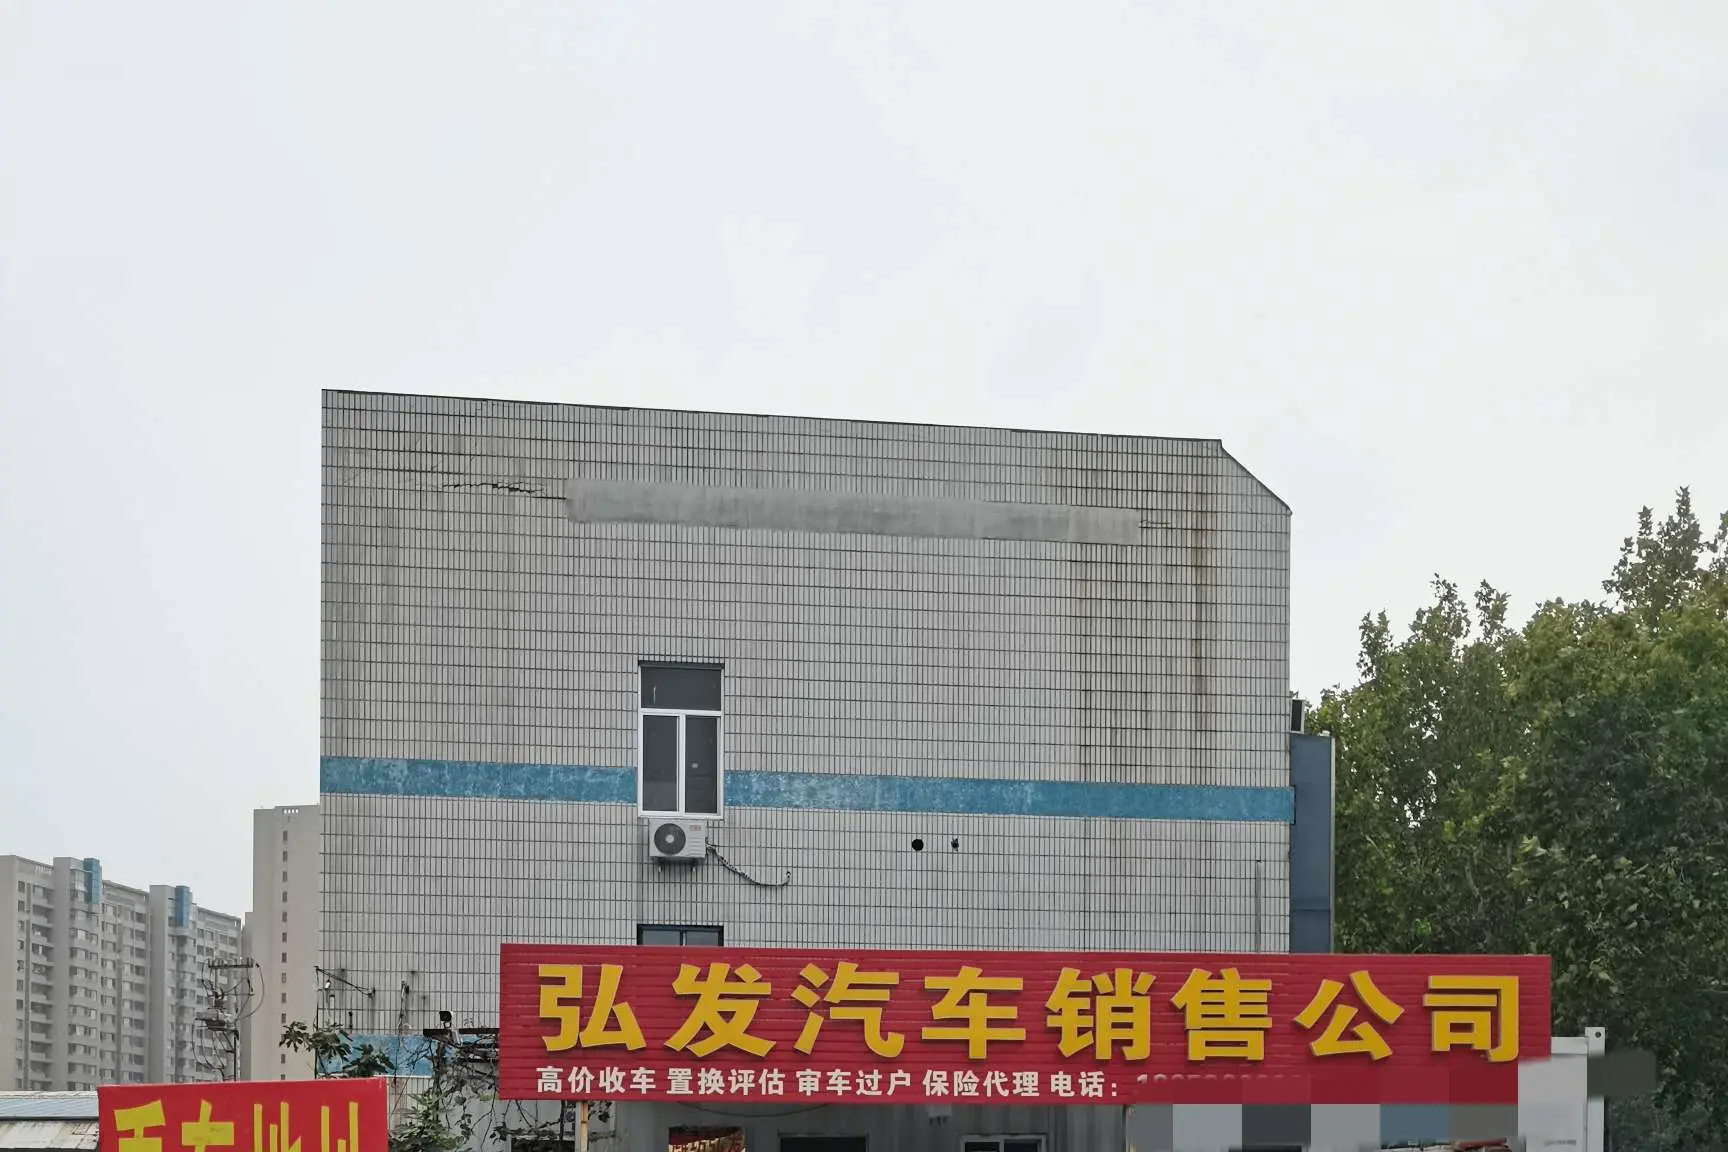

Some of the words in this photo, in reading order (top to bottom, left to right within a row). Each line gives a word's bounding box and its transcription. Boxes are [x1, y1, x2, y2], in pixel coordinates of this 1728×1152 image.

[540, 963, 1518, 1062] 弘发汽车销售公司
[536, 1065, 656, 1094] 高价收车
[666, 1067, 786, 1096] 置换评估
[795, 1068, 911, 1097] 审车过户
[922, 1069, 1040, 1098] 保险代理
